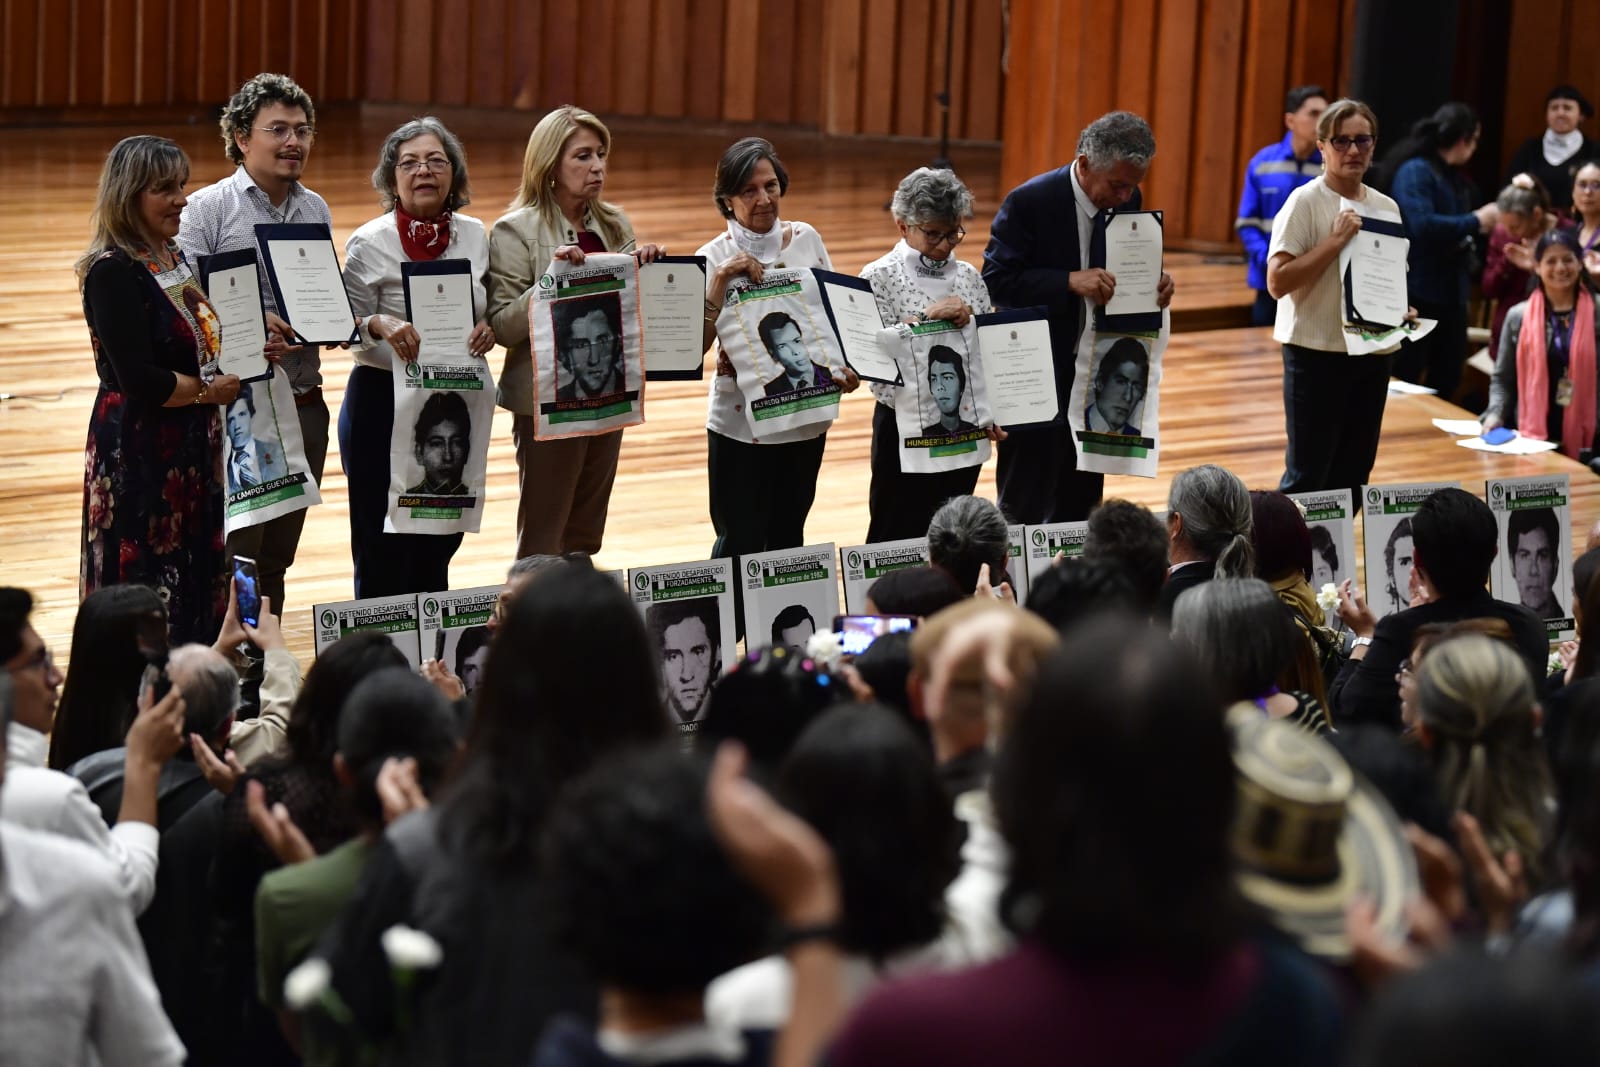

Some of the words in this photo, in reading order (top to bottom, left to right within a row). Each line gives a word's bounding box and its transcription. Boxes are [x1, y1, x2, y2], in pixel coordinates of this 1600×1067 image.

[555, 271, 583, 281] DETENIDO
[584, 266, 625, 277] DESAPARECIDO
[422, 365, 448, 373] DETENIDO
[448, 365, 485, 374] DESAPARECIDO
[753, 397, 780, 409] ALFREDO
[780, 393, 800, 403] RAFAEL
[906, 438, 944, 447] HUMBERTO
[236, 485, 265, 500] CAMPOS
[266, 475, 299, 490] GUEVARA
[399, 498, 421, 506] EDGAR
[1307, 501, 1337, 510] ZADAMENTE
[1047, 529, 1077, 539] DETENIDO
[761, 558, 790, 569] DETENIDO
[790, 552, 830, 565] DESAPARECIDO
[862, 550, 890, 560] DETENIDO
[876, 554, 921, 567] FORZADAMENTE
[651, 571, 681, 582] DETENIDO
[681, 566, 724, 578] DESAPARECIDO
[776, 562, 820, 575] FORZADAMENTE
[666, 576, 713, 588] FORZADAMENTE
[779, 576, 786, 584] de
[786, 575, 803, 583] marzo
[803, 573, 810, 581] de
[810, 571, 824, 579] 1982
[662, 591, 670, 599] de
[670, 588, 700, 598] septiembre
[708, 584, 723, 593] 1982
[440, 596, 473, 608] DETENIDO
[474, 593, 499, 604] DESAPA
[339, 608, 372, 619] DETENIDO
[373, 602, 417, 615] DESAPARECID
[457, 603, 492, 614] FORZADAM
[356, 612, 408, 626] FORZADAMENTE
[450, 618, 459, 626] 23
[459, 617, 467, 625] de
[468, 615, 489, 625] agosto
[391, 623, 400, 631] de
[400, 621, 416, 631] 1982
